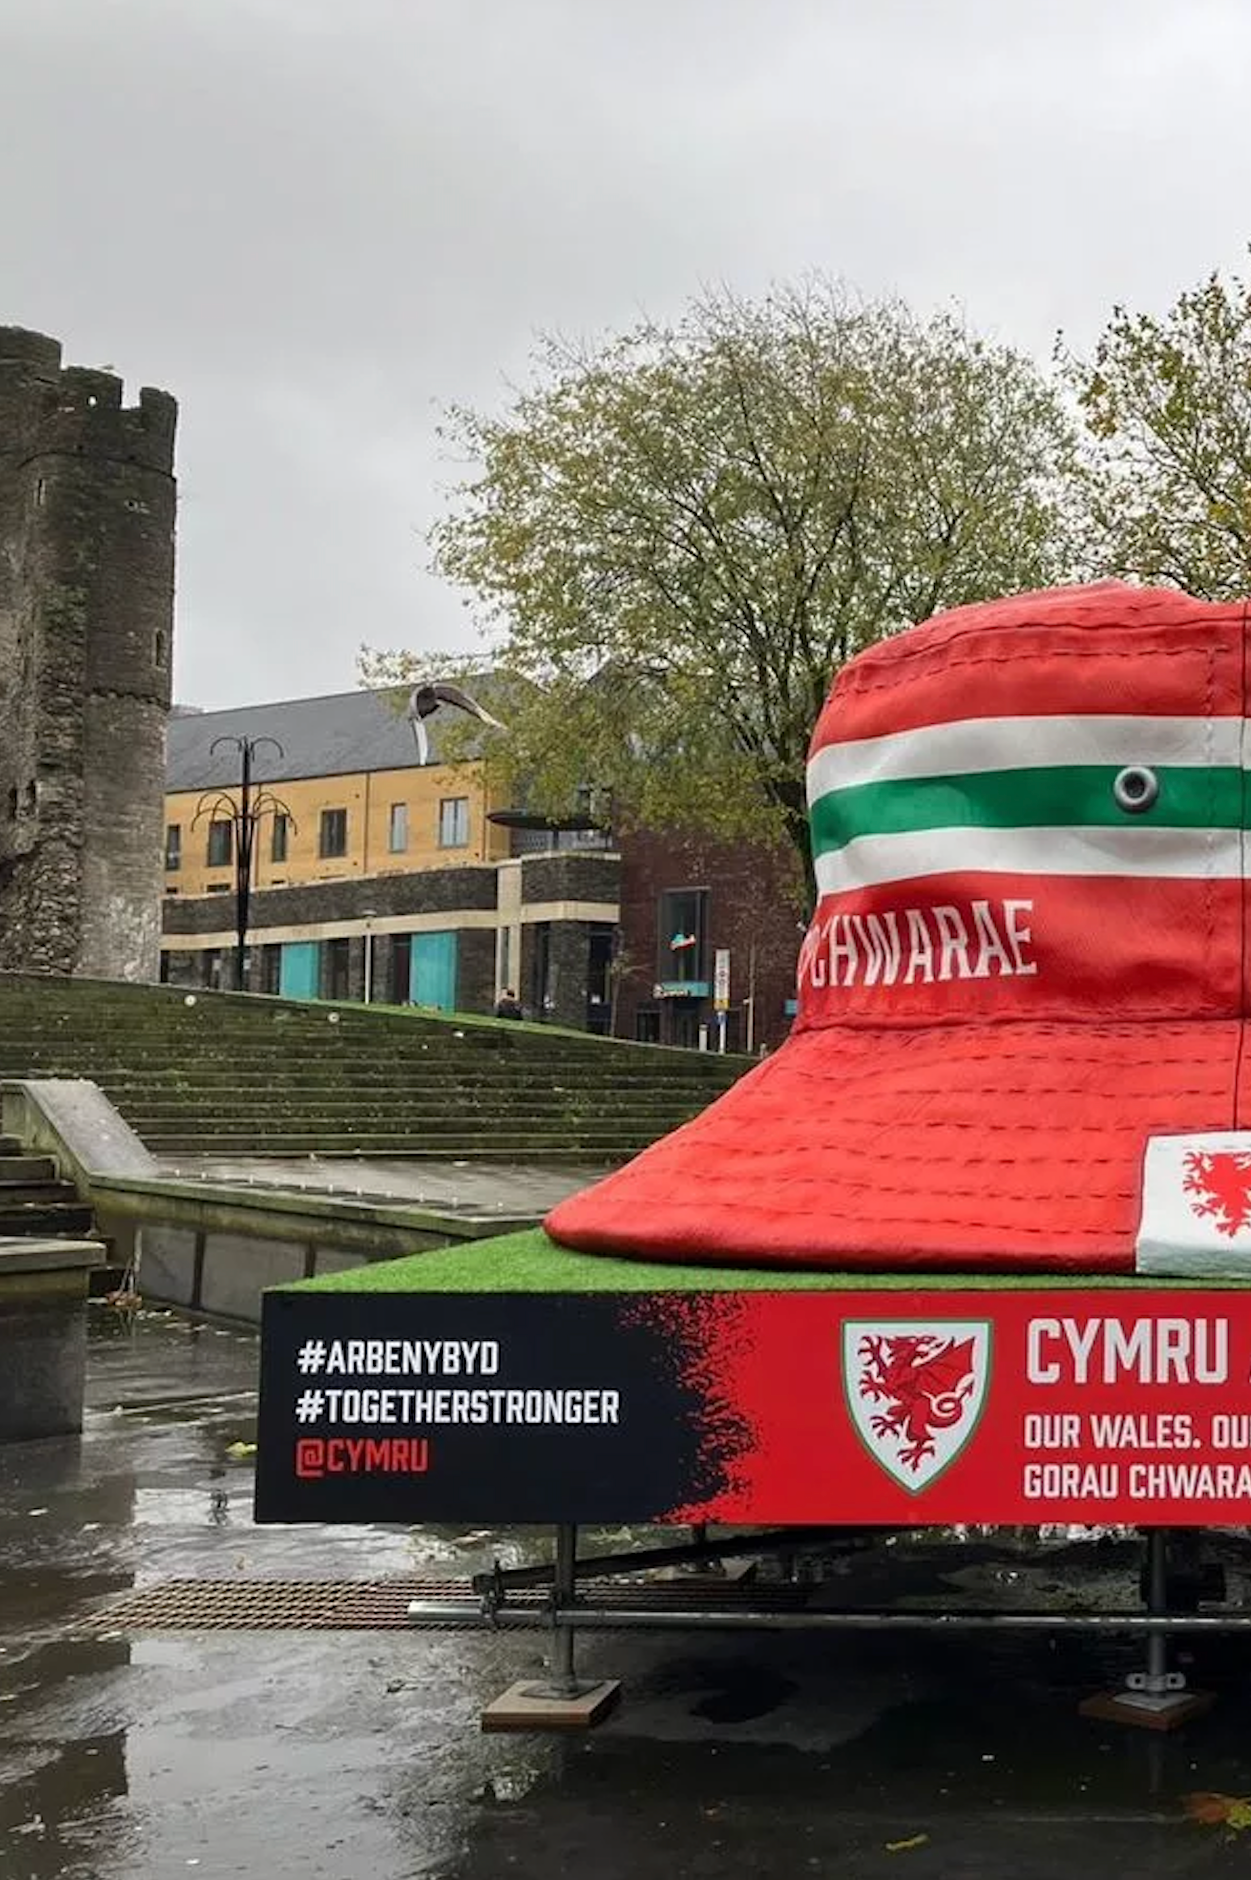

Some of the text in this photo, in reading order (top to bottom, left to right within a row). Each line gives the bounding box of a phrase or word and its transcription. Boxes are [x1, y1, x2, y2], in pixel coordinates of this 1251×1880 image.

[810, 899, 1038, 988] CHWARAE
[297, 1339, 499, 1375] #ARBENYBYD
[1026, 1318, 1229, 1384] CYMRU
[295, 1389, 620, 1424] #TOGETHERSTRONGER
[1024, 1414, 1081, 1449] OUR
[1089, 1414, 1202, 1449] WALES.
[295, 1438, 429, 1478] @CYMRU
[1023, 1463, 1119, 1499] GORAU
